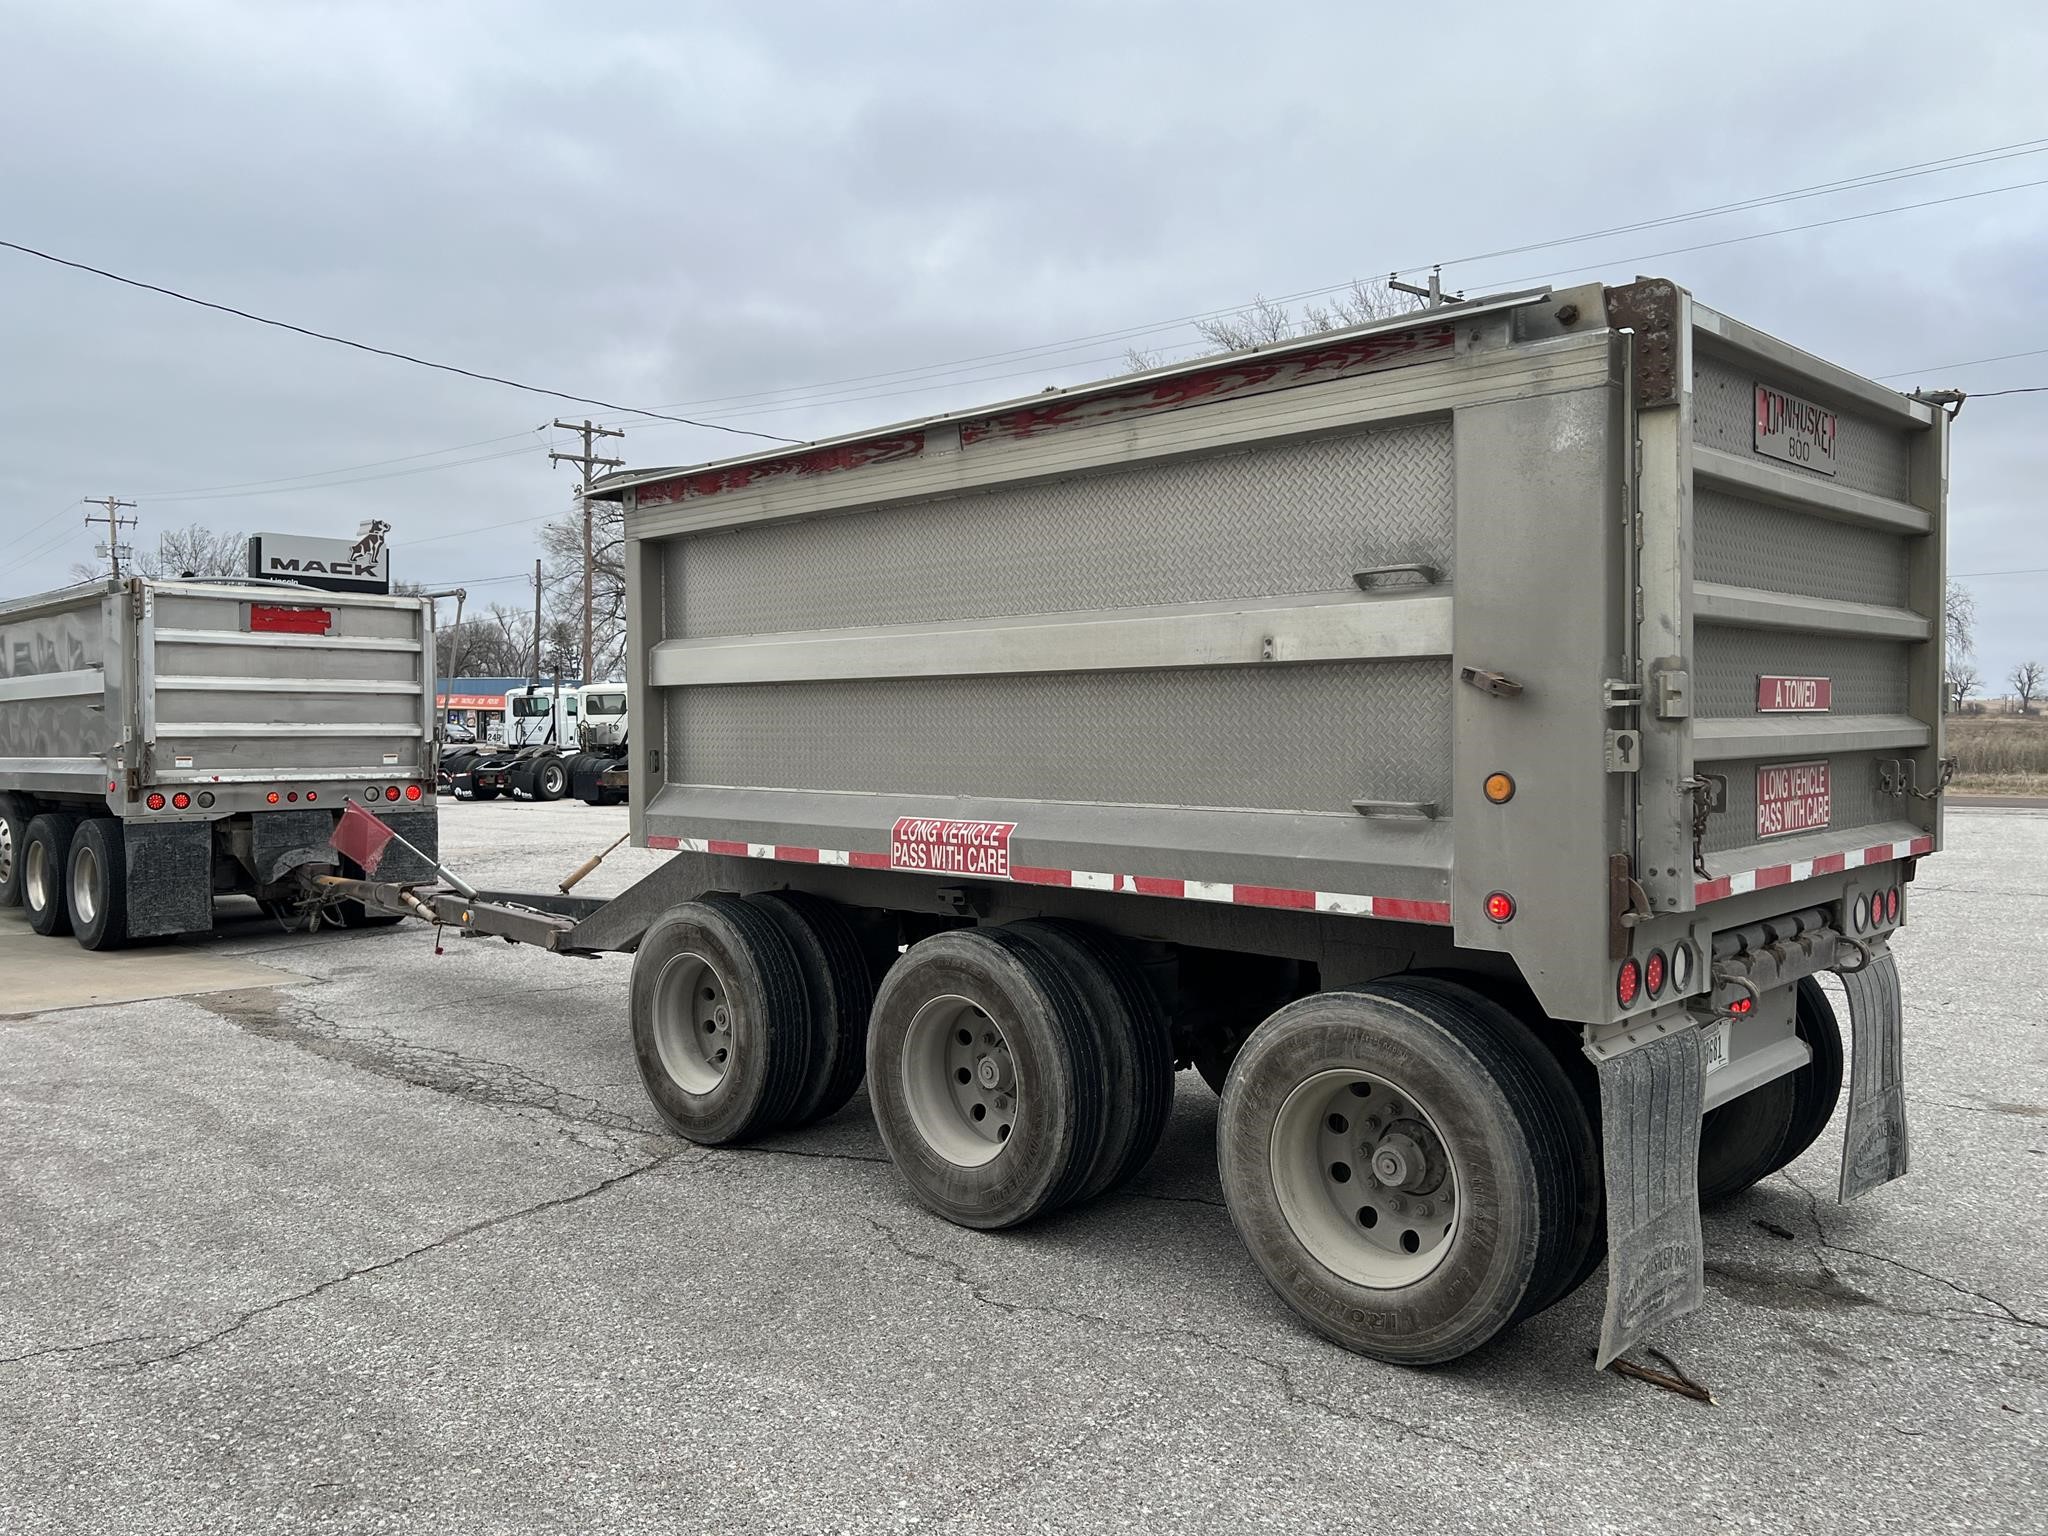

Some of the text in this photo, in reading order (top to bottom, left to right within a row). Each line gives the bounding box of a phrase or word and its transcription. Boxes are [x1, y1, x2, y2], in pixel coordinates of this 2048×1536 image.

[1789, 436, 1810, 462] 800
[270, 577, 299, 585] Lincoln
[271, 557, 378, 577] MACK
[1776, 680, 1816, 708] A TOWED
[1764, 766, 1825, 801] LONG VEHICLE
[1760, 795, 1830, 834] PASS WITH CARE
[900, 819, 1005, 847] LONG VEHICLE
[893, 841, 1007, 874] PASS WITH CARE
